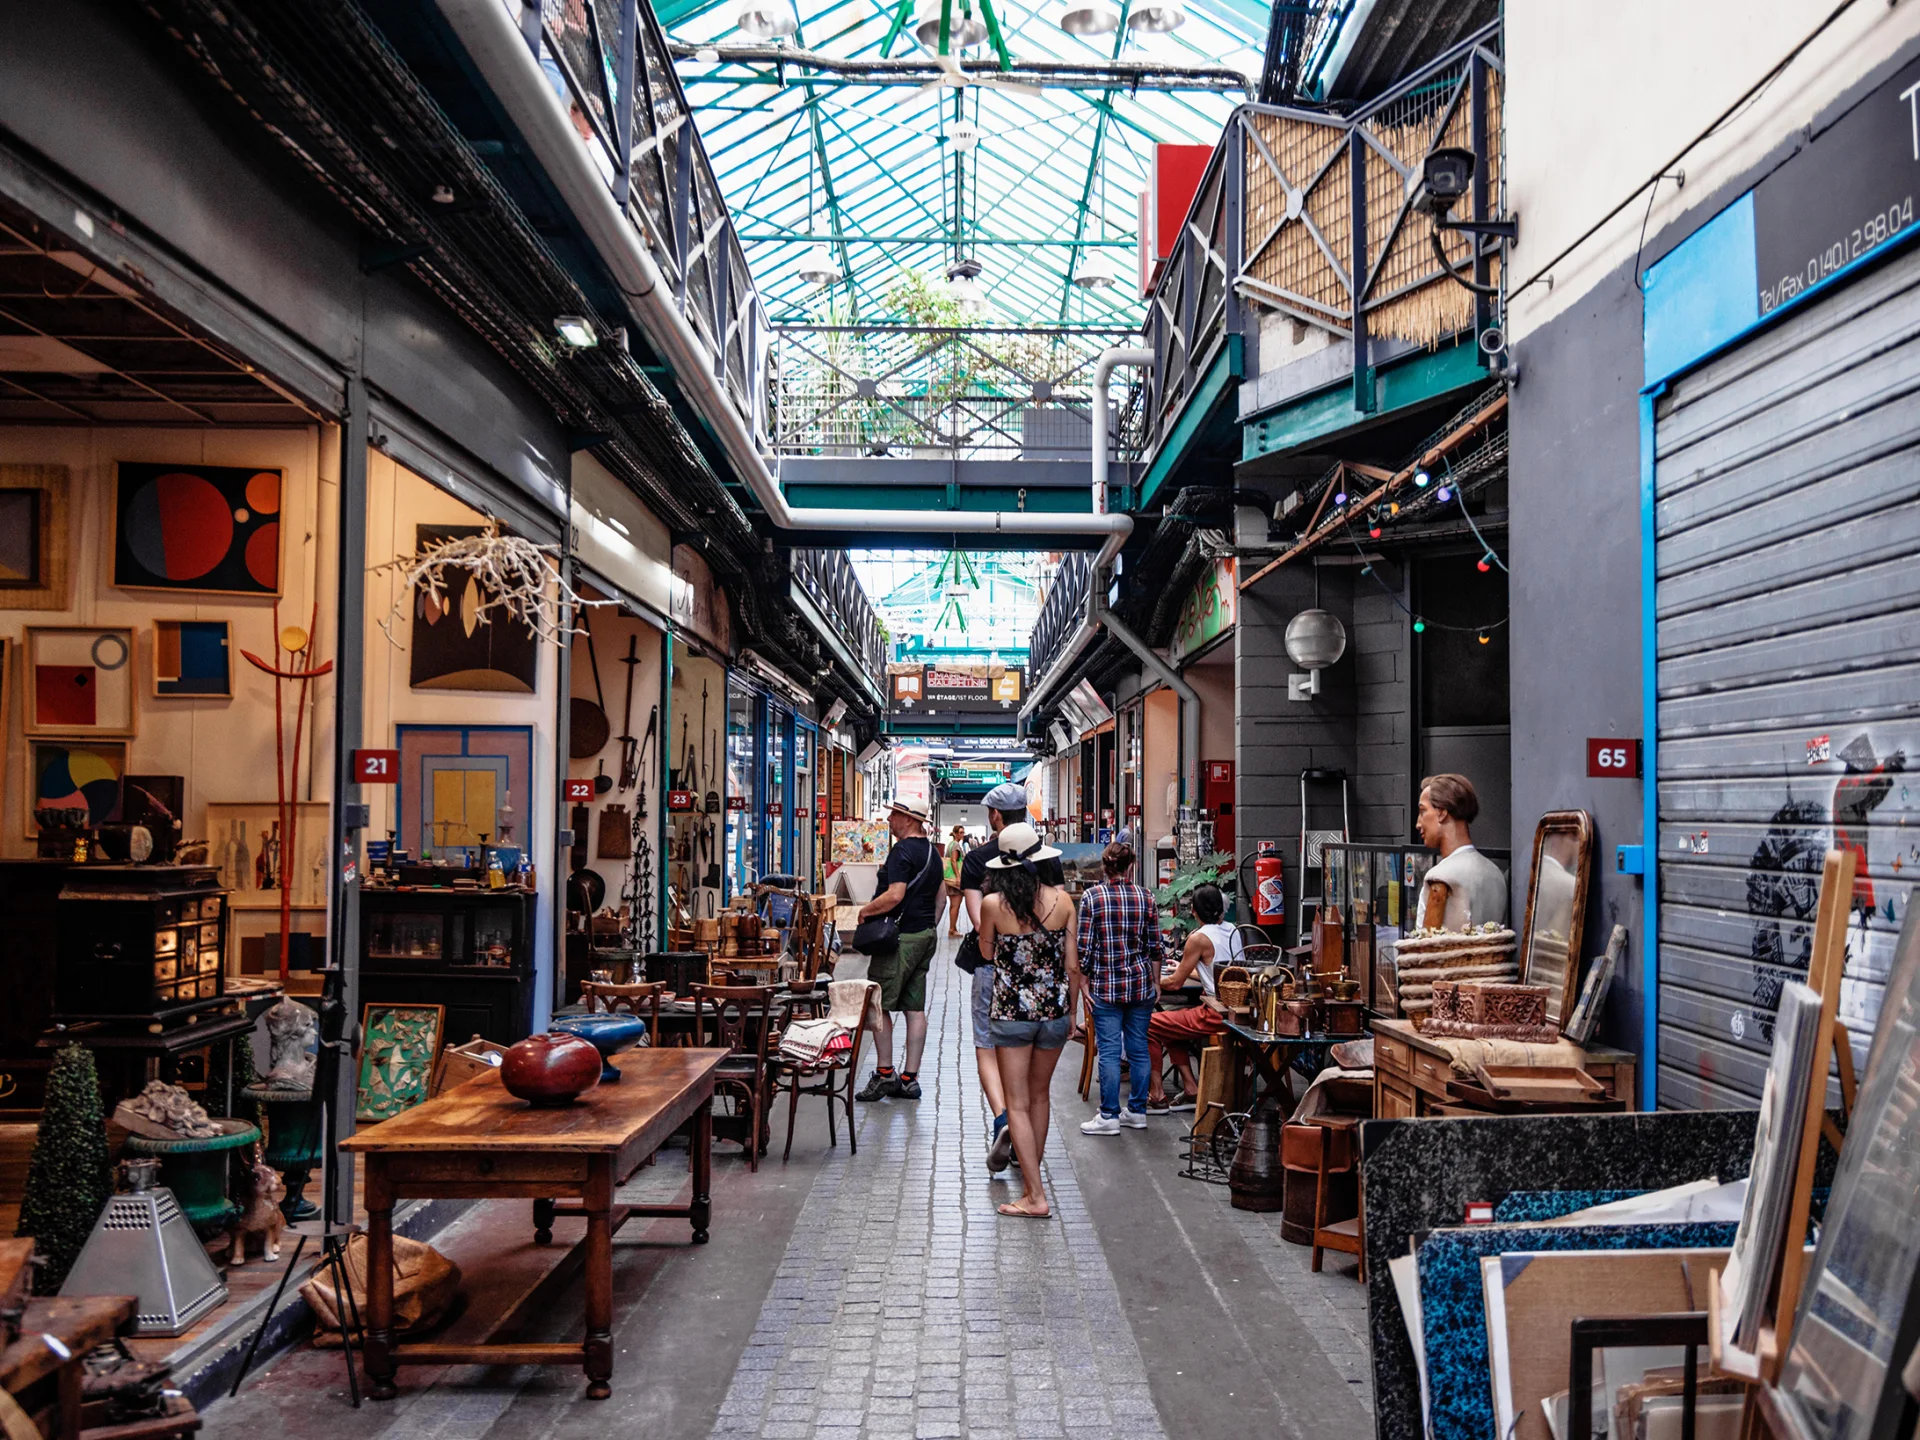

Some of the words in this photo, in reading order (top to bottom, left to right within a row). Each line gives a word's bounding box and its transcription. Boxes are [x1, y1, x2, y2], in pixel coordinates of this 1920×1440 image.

[1760, 271, 1804, 314] Tel/Fax
[979, 738, 999, 746] BOOK
[1597, 747, 1627, 768] 65
[365, 757, 387, 775] 21
[571, 785, 589, 797] 22
[673, 795, 687, 804] 23
[731, 799, 742, 807] 24
